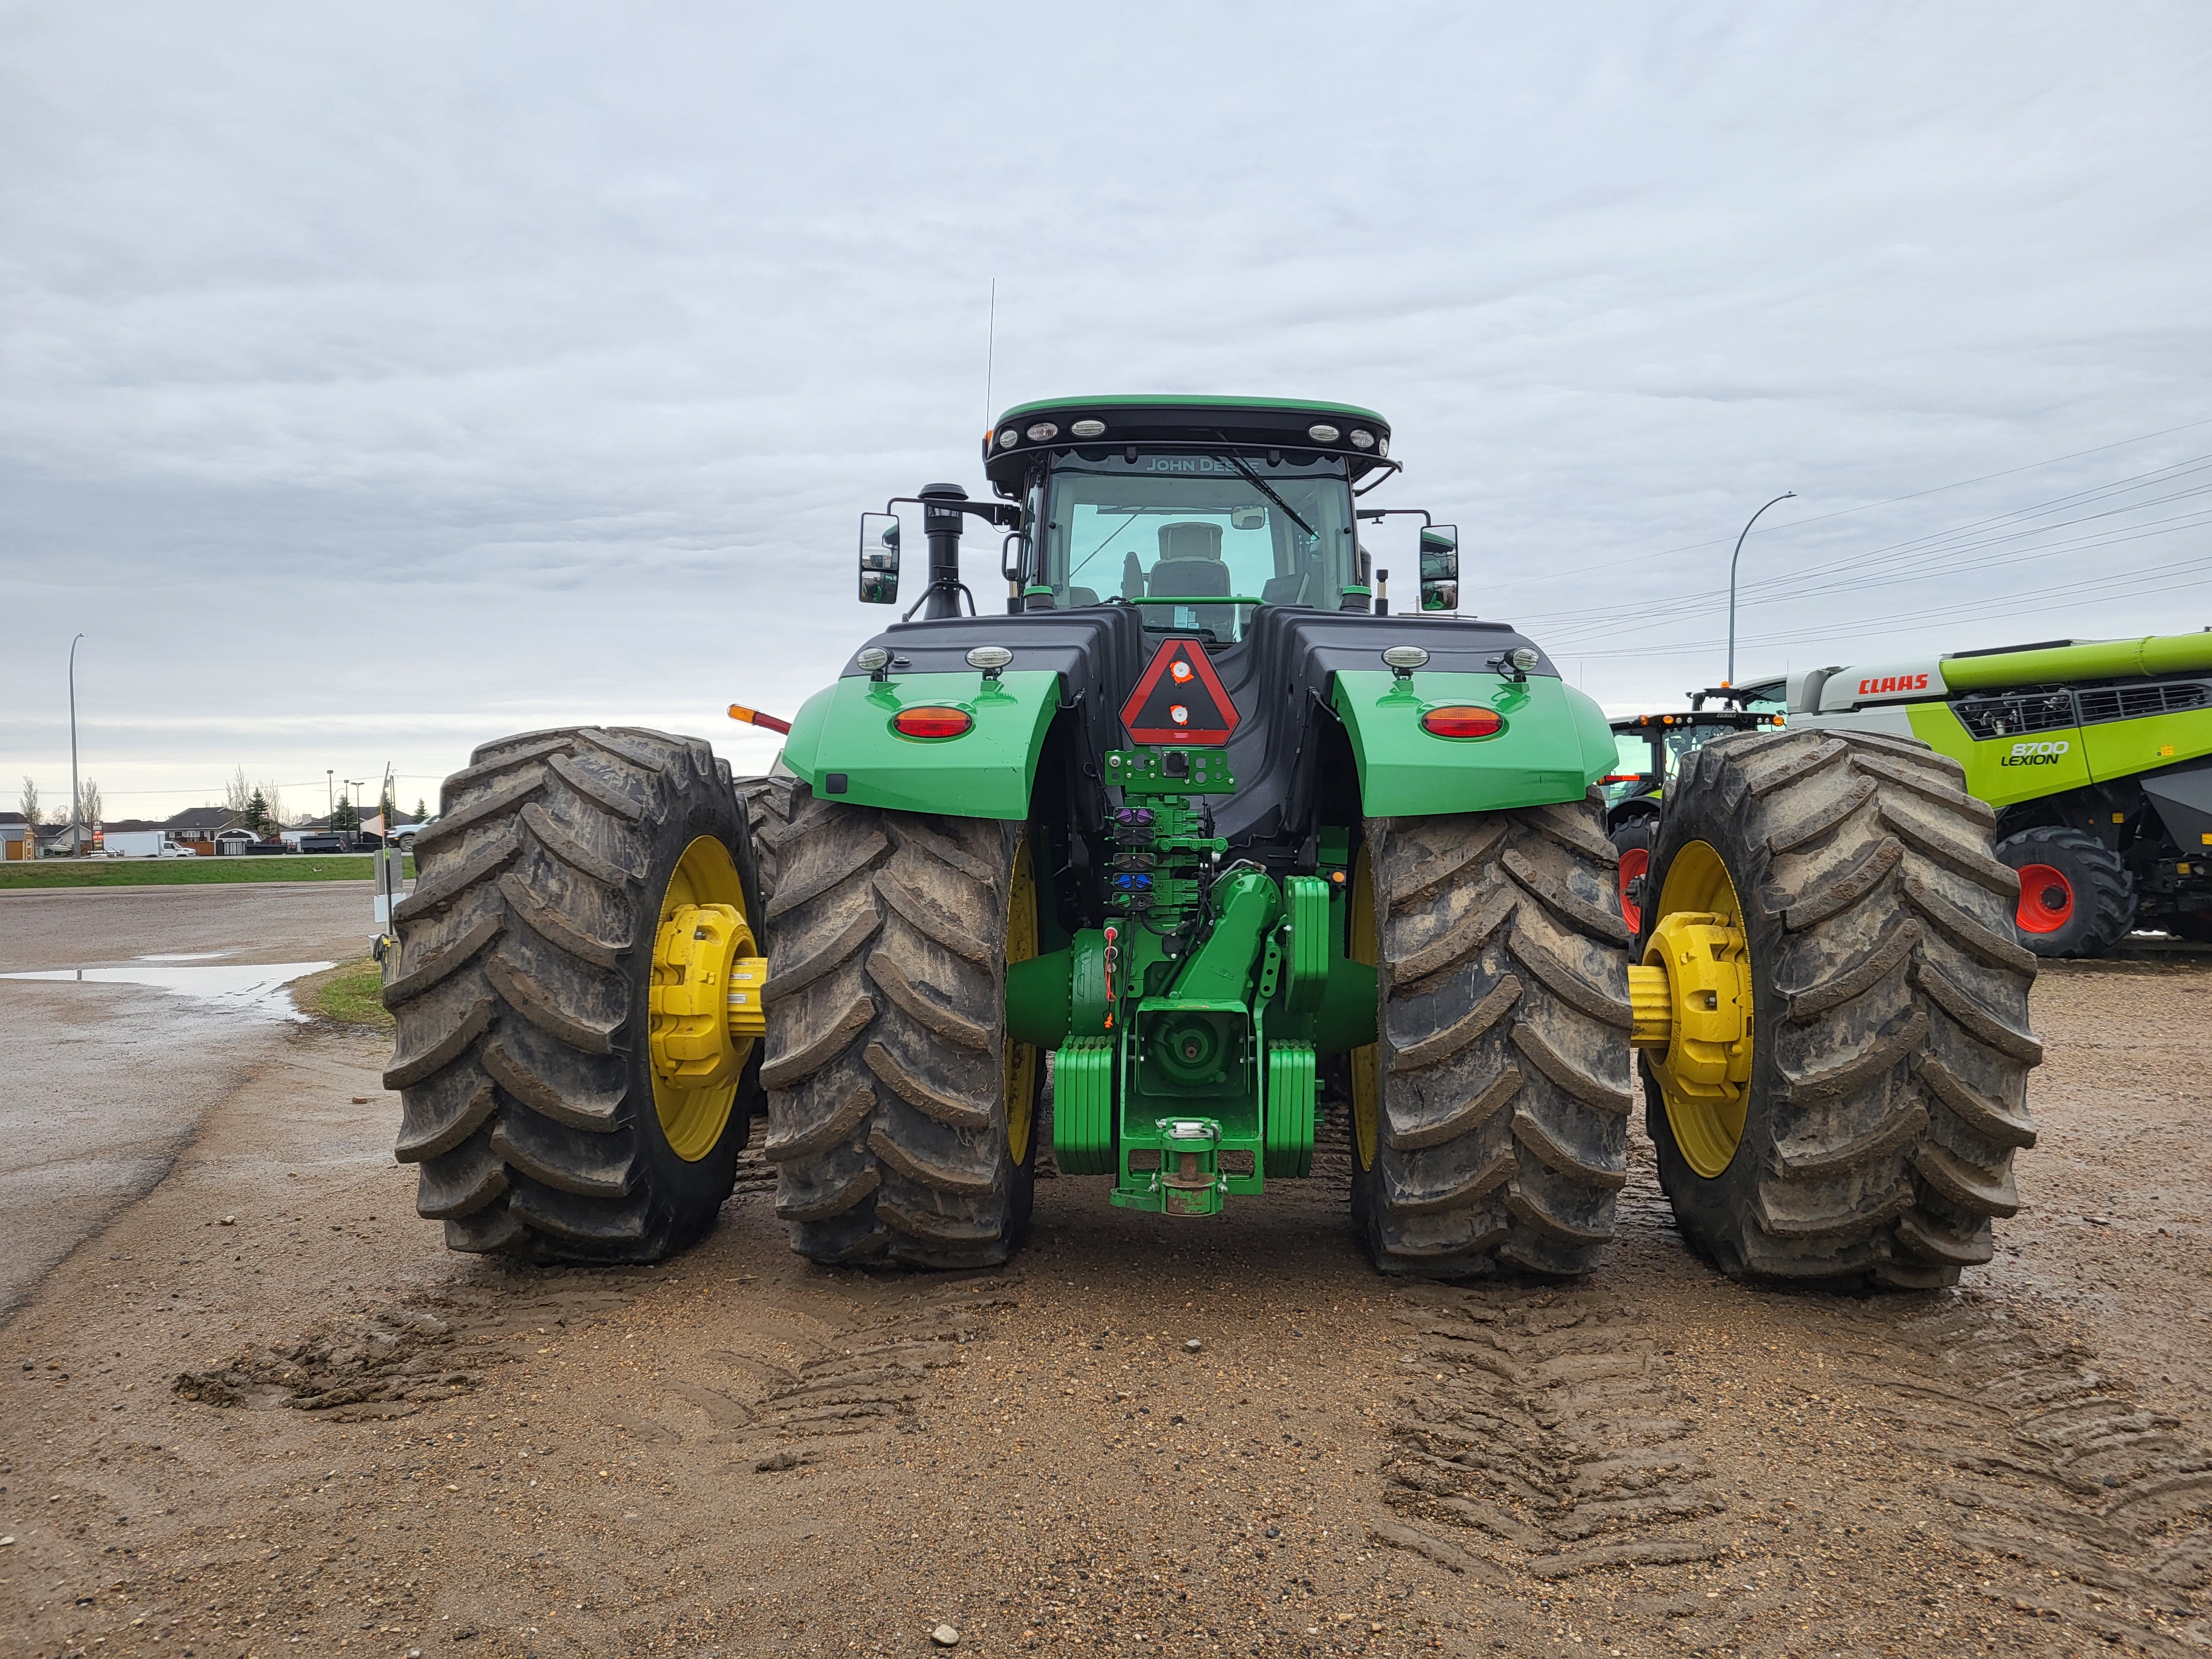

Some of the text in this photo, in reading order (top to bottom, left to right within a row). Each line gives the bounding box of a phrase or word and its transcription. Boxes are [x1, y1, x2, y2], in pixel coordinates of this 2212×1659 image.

[1146, 457, 1195, 471] JOHN
[1859, 674, 1929, 695] CLAAS
[2011, 741, 2069, 756] 8700
[2001, 754, 2059, 766] LEXION
